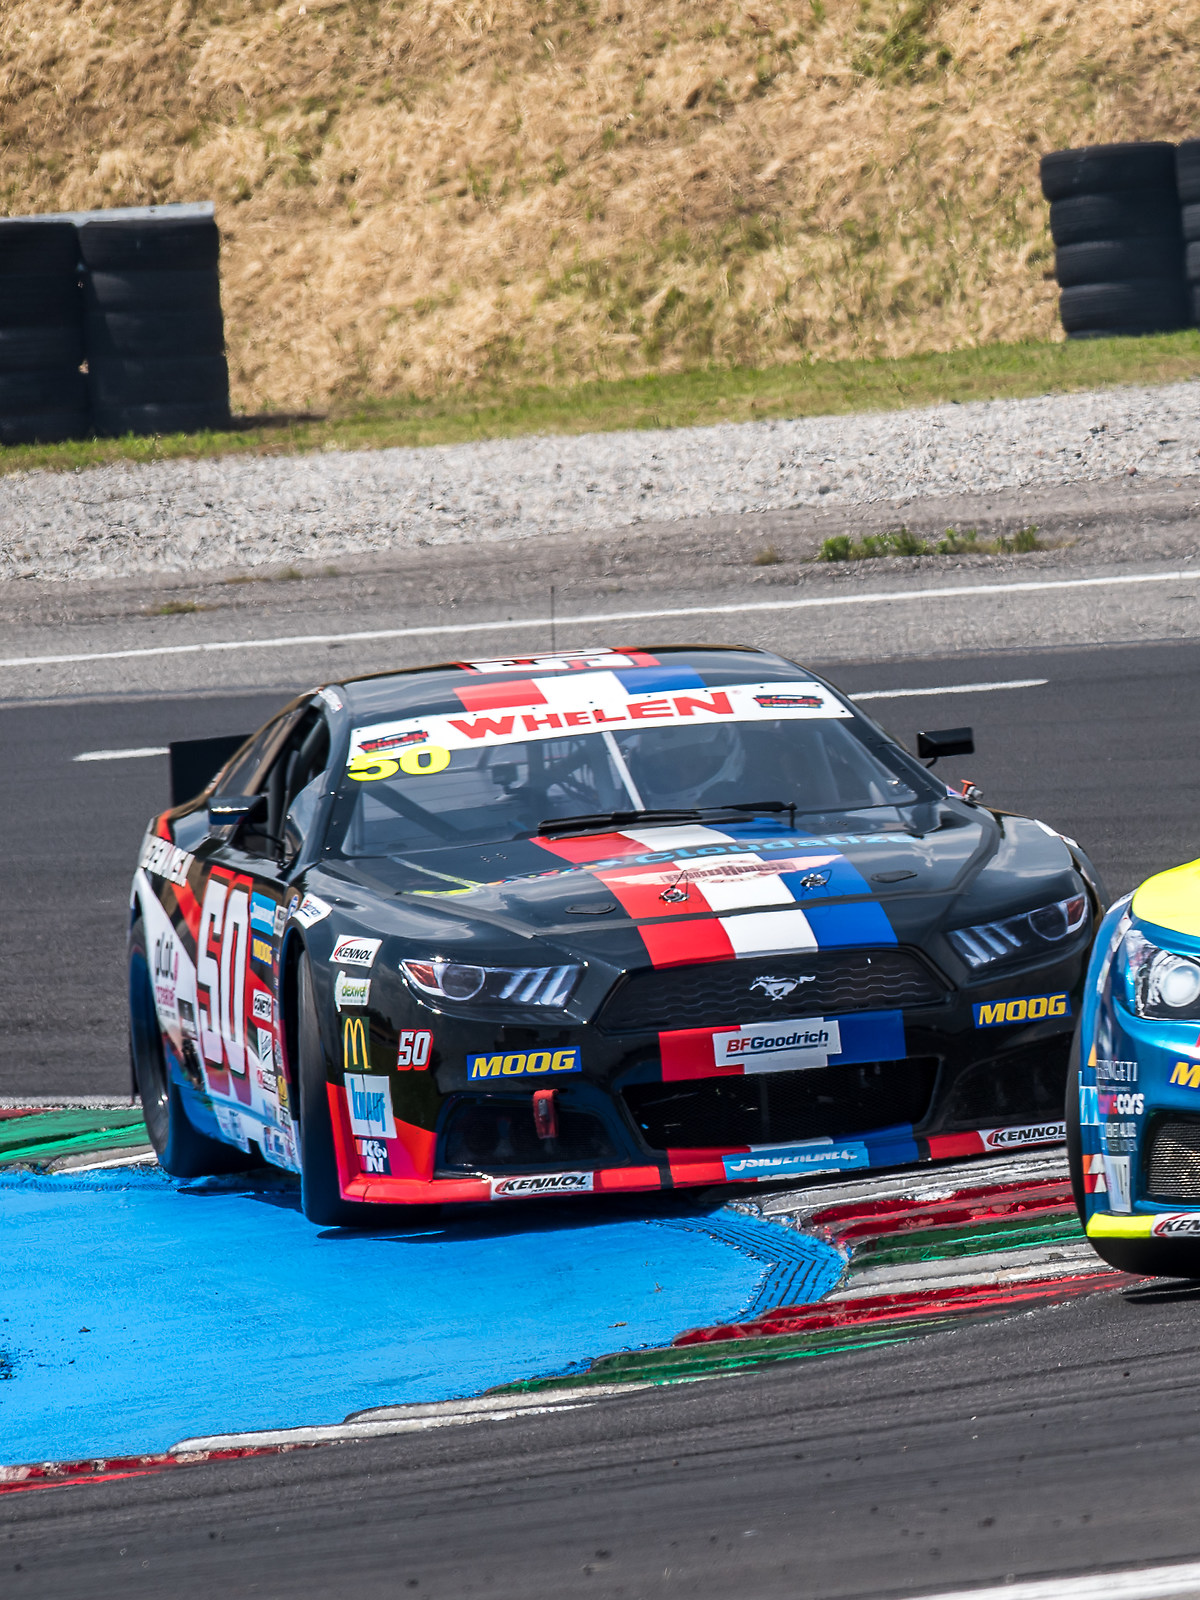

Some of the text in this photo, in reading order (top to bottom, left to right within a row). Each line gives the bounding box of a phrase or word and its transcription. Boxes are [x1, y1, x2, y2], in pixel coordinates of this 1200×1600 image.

[447, 692, 733, 739] WHELEN
[348, 746, 450, 781] 50
[337, 947, 372, 960] KENNOL
[197, 868, 252, 1085] 50
[978, 994, 1066, 1025] MOOG
[398, 1030, 433, 1069] 50
[726, 1030, 829, 1053] BFGoodrich
[472, 1050, 577, 1078] MOOG
[993, 1125, 1066, 1143] KENNOL
[501, 1175, 587, 1191] KENNOL
